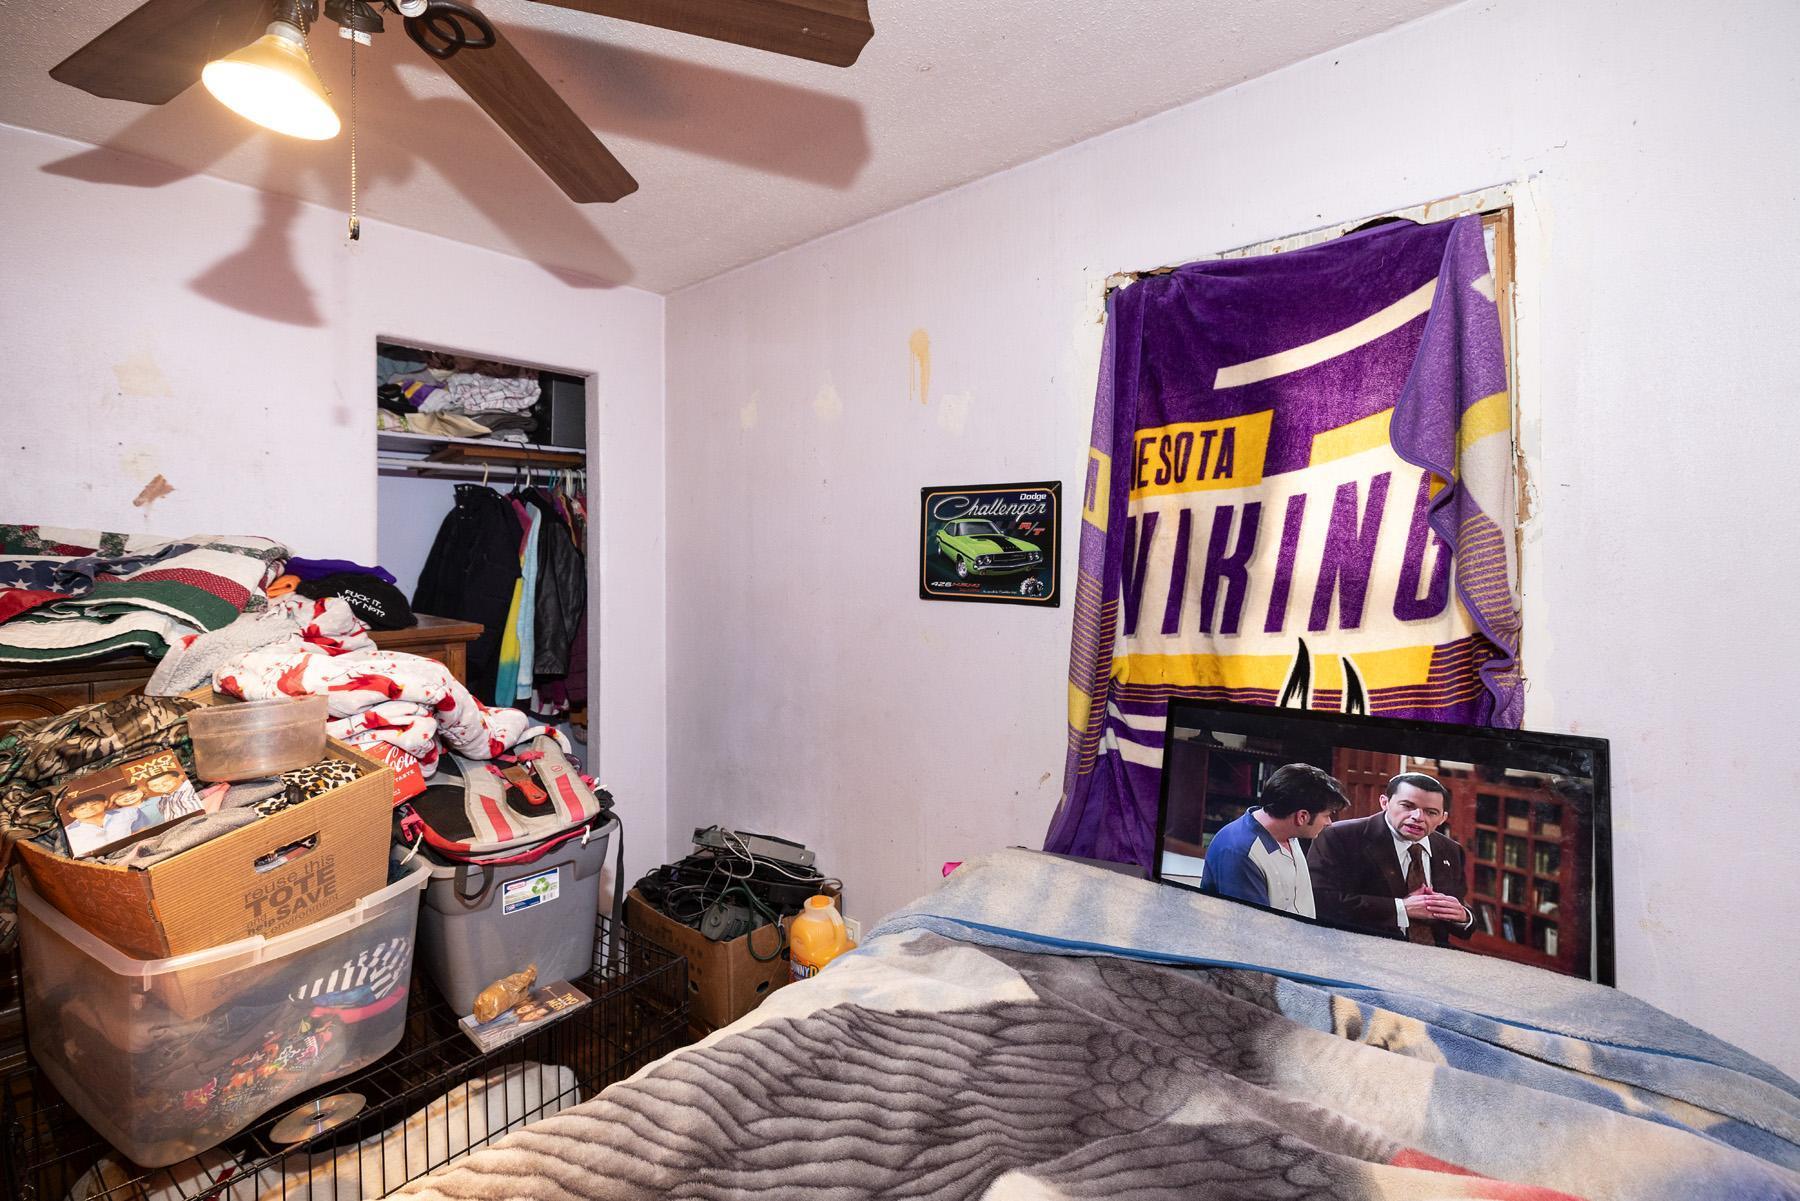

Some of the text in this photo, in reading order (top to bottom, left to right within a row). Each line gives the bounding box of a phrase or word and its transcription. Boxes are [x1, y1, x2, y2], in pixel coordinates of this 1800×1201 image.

[933, 496, 1047, 522] Challenger
[1020, 492, 1047, 502] Dodge
[1018, 521, 1046, 536] R/T
[336, 591, 386, 618] WHY NOT?
[344, 589, 371, 603] FUCK
[125, 754, 173, 774] TWO
[130, 761, 177, 785] MEN
[244, 854, 335, 903] reuse this
[244, 863, 336, 917] TOTE
[276, 881, 336, 920] SAVE
